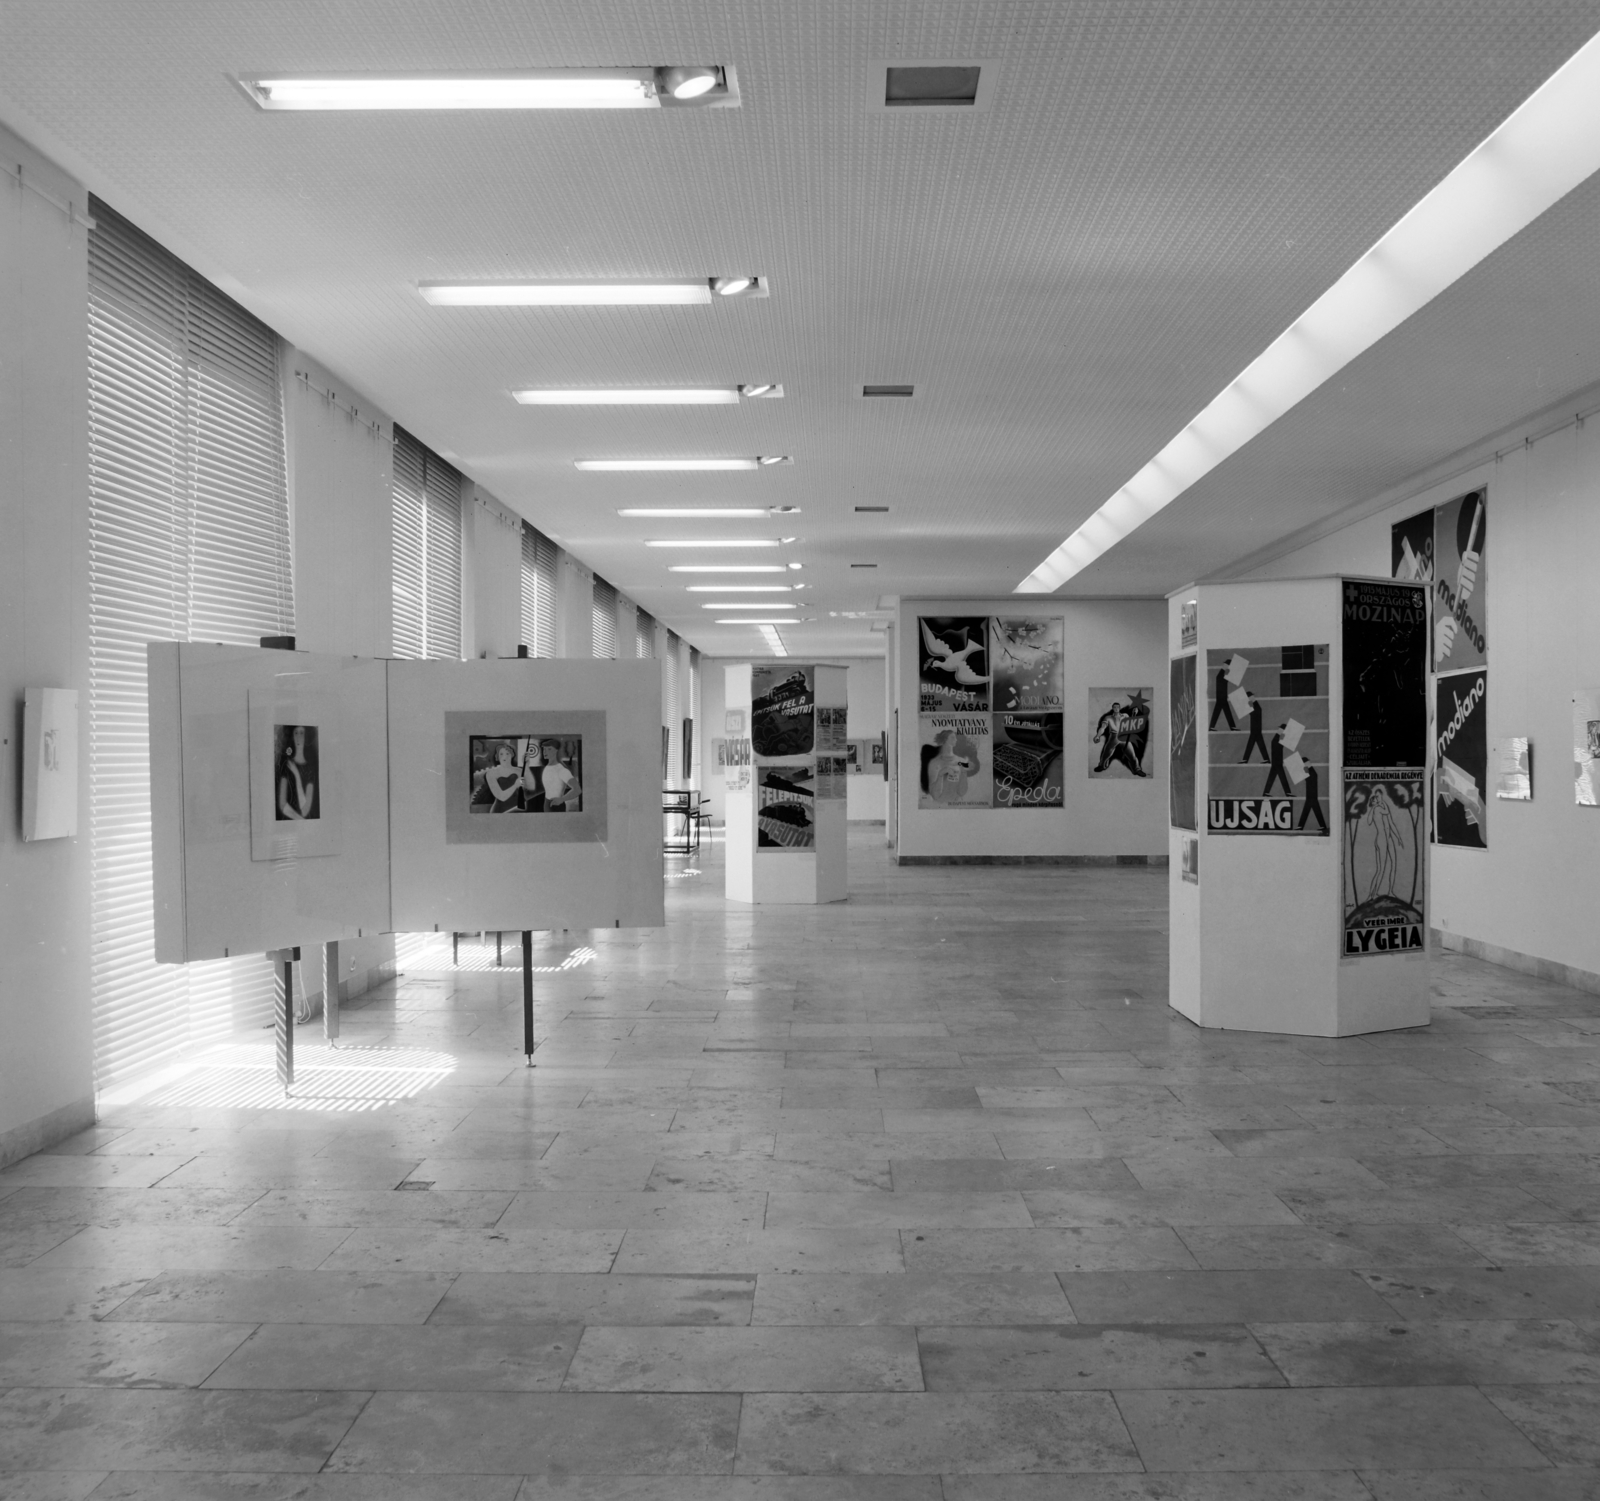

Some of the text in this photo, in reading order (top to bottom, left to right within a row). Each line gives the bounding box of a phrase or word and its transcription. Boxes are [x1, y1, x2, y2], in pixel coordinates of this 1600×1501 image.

[1359, 594, 1411, 607] ORSZÁGOS
[1344, 604, 1425, 625] MOZINAP
[1437, 579, 1485, 654] modiano
[921, 683, 977, 702] BUDAPEST
[781, 703, 814, 716] VASUTAT
[782, 699, 796, 710] FEL
[799, 695, 806, 705] A
[953, 701, 989, 712] VÁSÁR
[1004, 715, 1013, 725] 10
[1120, 717, 1144, 733] MKP
[1437, 677, 1485, 758] modiano
[1345, 772, 1352, 780] AZ
[996, 776, 1061, 806] Epeda
[1387, 917, 1405, 925] IMRE
[1346, 926, 1422, 953] LYGEIA
